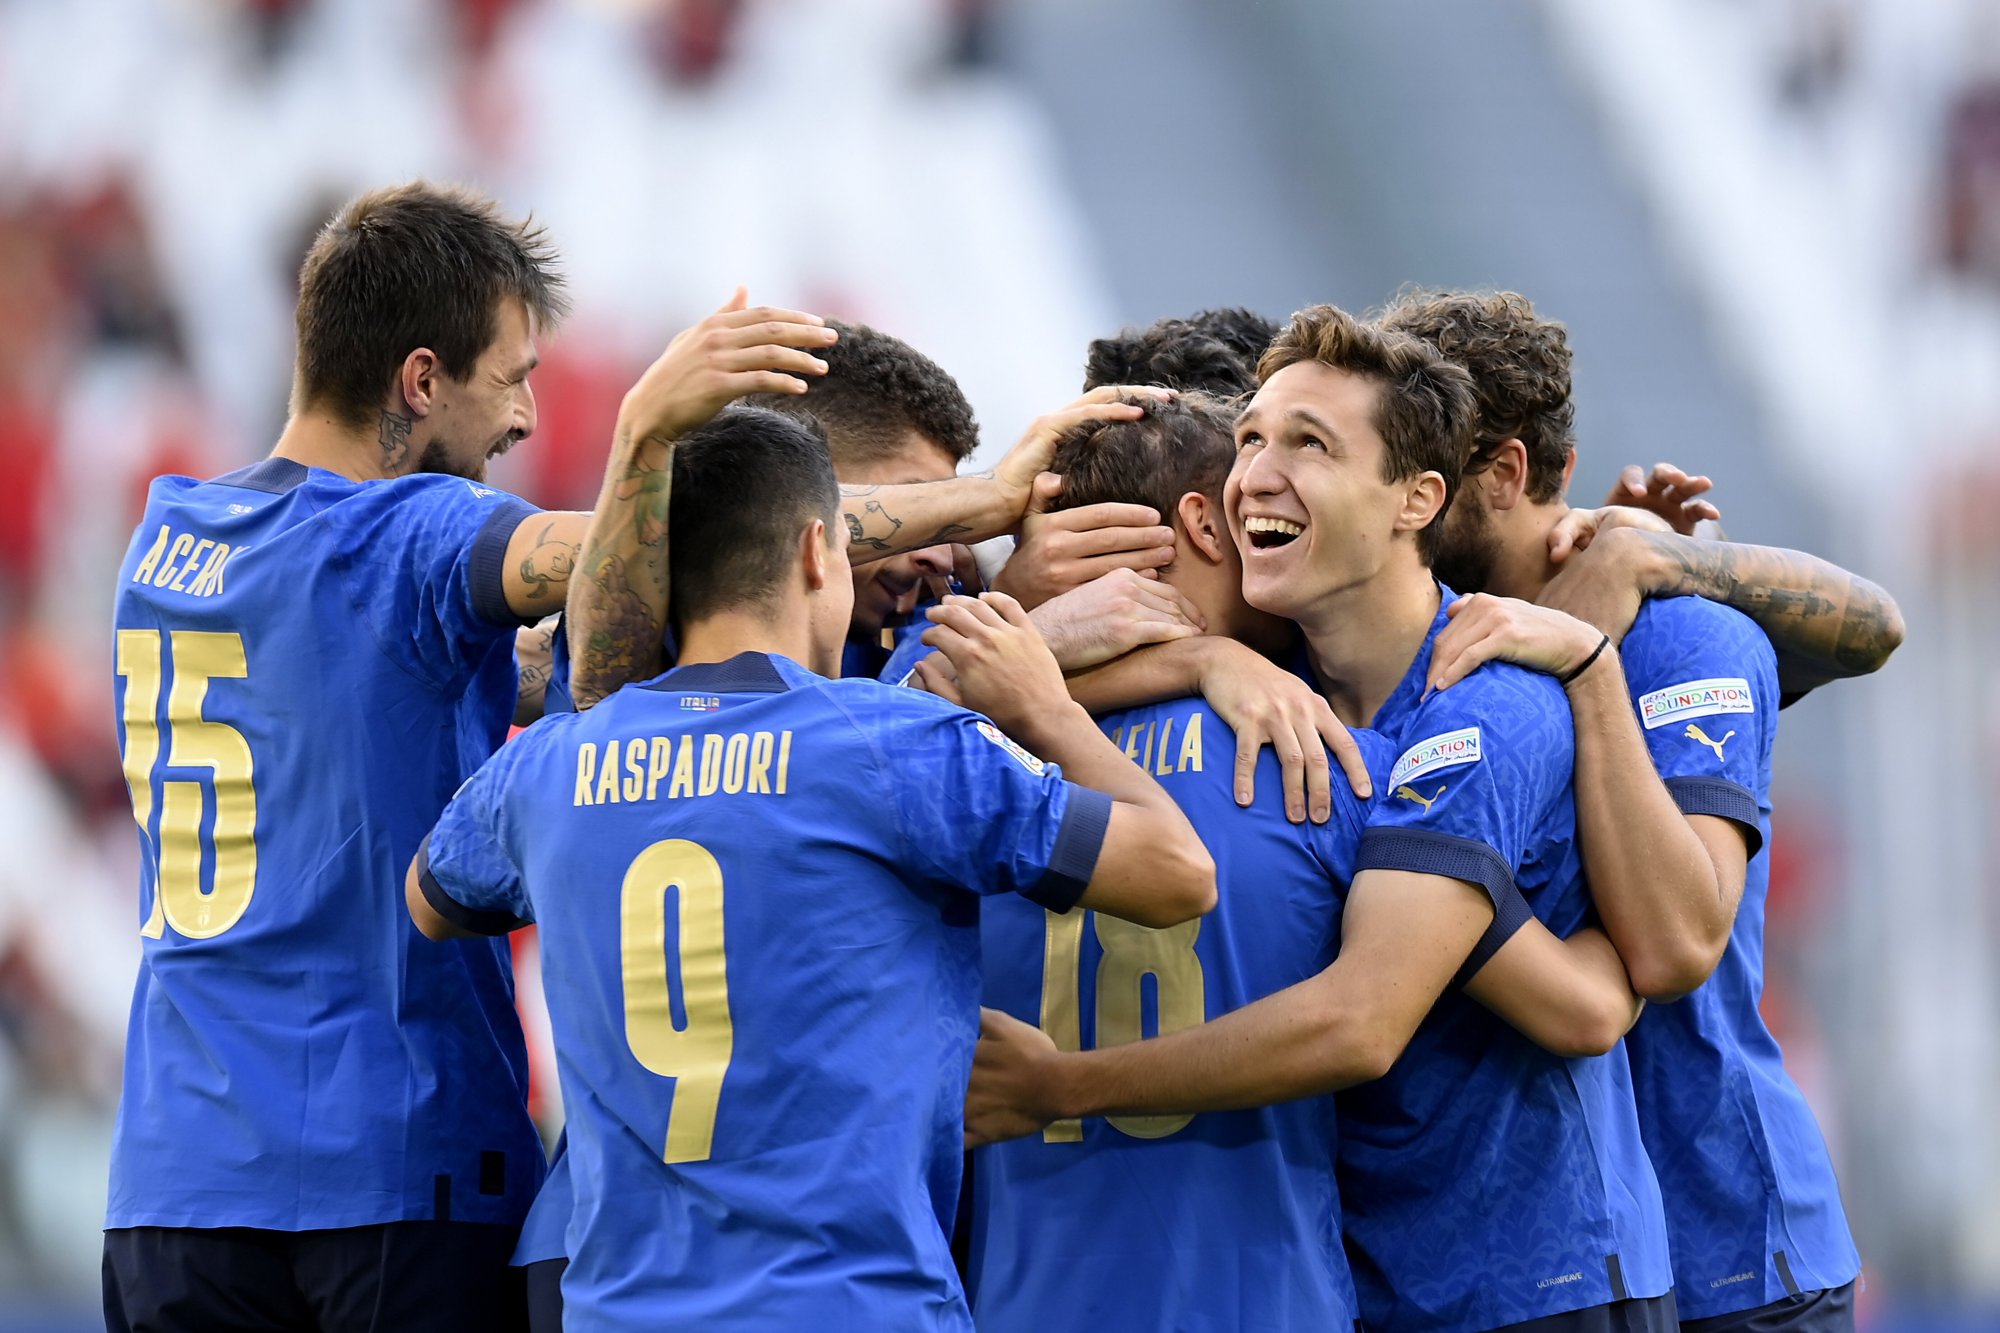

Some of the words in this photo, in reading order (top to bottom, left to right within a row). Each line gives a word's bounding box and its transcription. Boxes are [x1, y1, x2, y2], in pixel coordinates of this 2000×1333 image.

[132, 524, 234, 598] ACER
[680, 696, 720, 707] ITALIA
[1645, 689, 1749, 716] FOUNDATION
[116, 629, 257, 939] 15
[573, 730, 793, 806] RASPADORI
[620, 838, 734, 1164] 9
[1536, 1271, 1583, 1289] ULTRAWEAVE
[1709, 1271, 1756, 1289] ULTRAWEAVE
